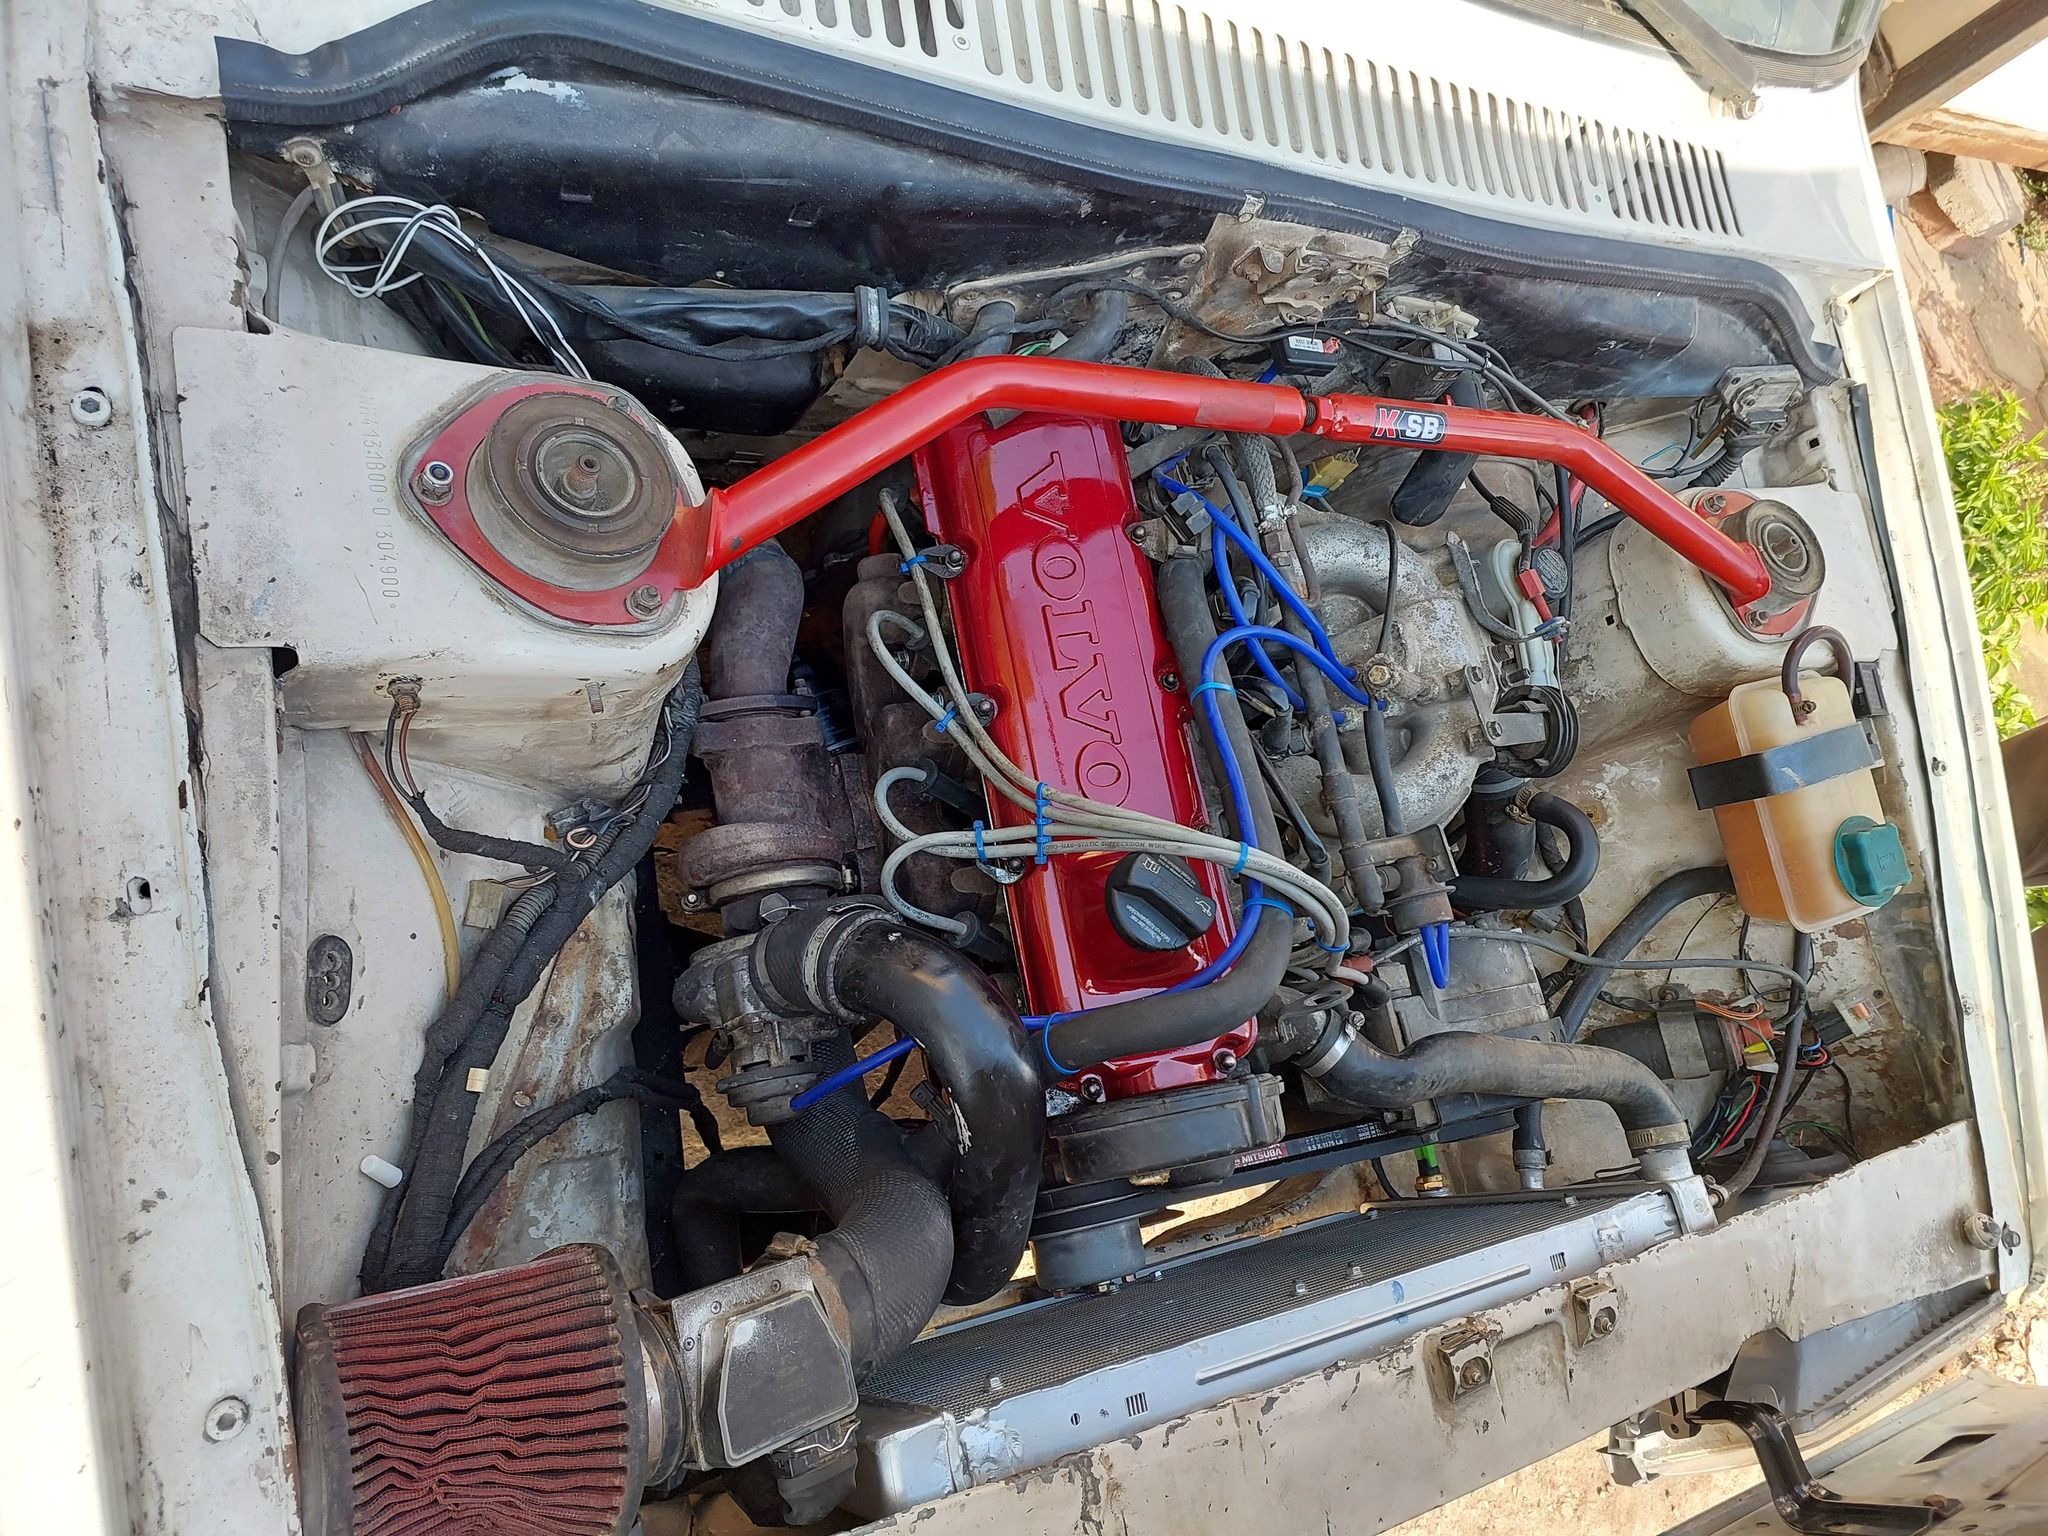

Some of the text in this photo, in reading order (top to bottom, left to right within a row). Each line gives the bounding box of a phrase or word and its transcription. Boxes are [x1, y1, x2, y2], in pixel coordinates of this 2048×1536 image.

[1016, 450, 1131, 808] VOLVO
[1246, 858, 1310, 885] ONO-MAG-STATIC
[1241, 1150, 1283, 1164] MITSUBA
